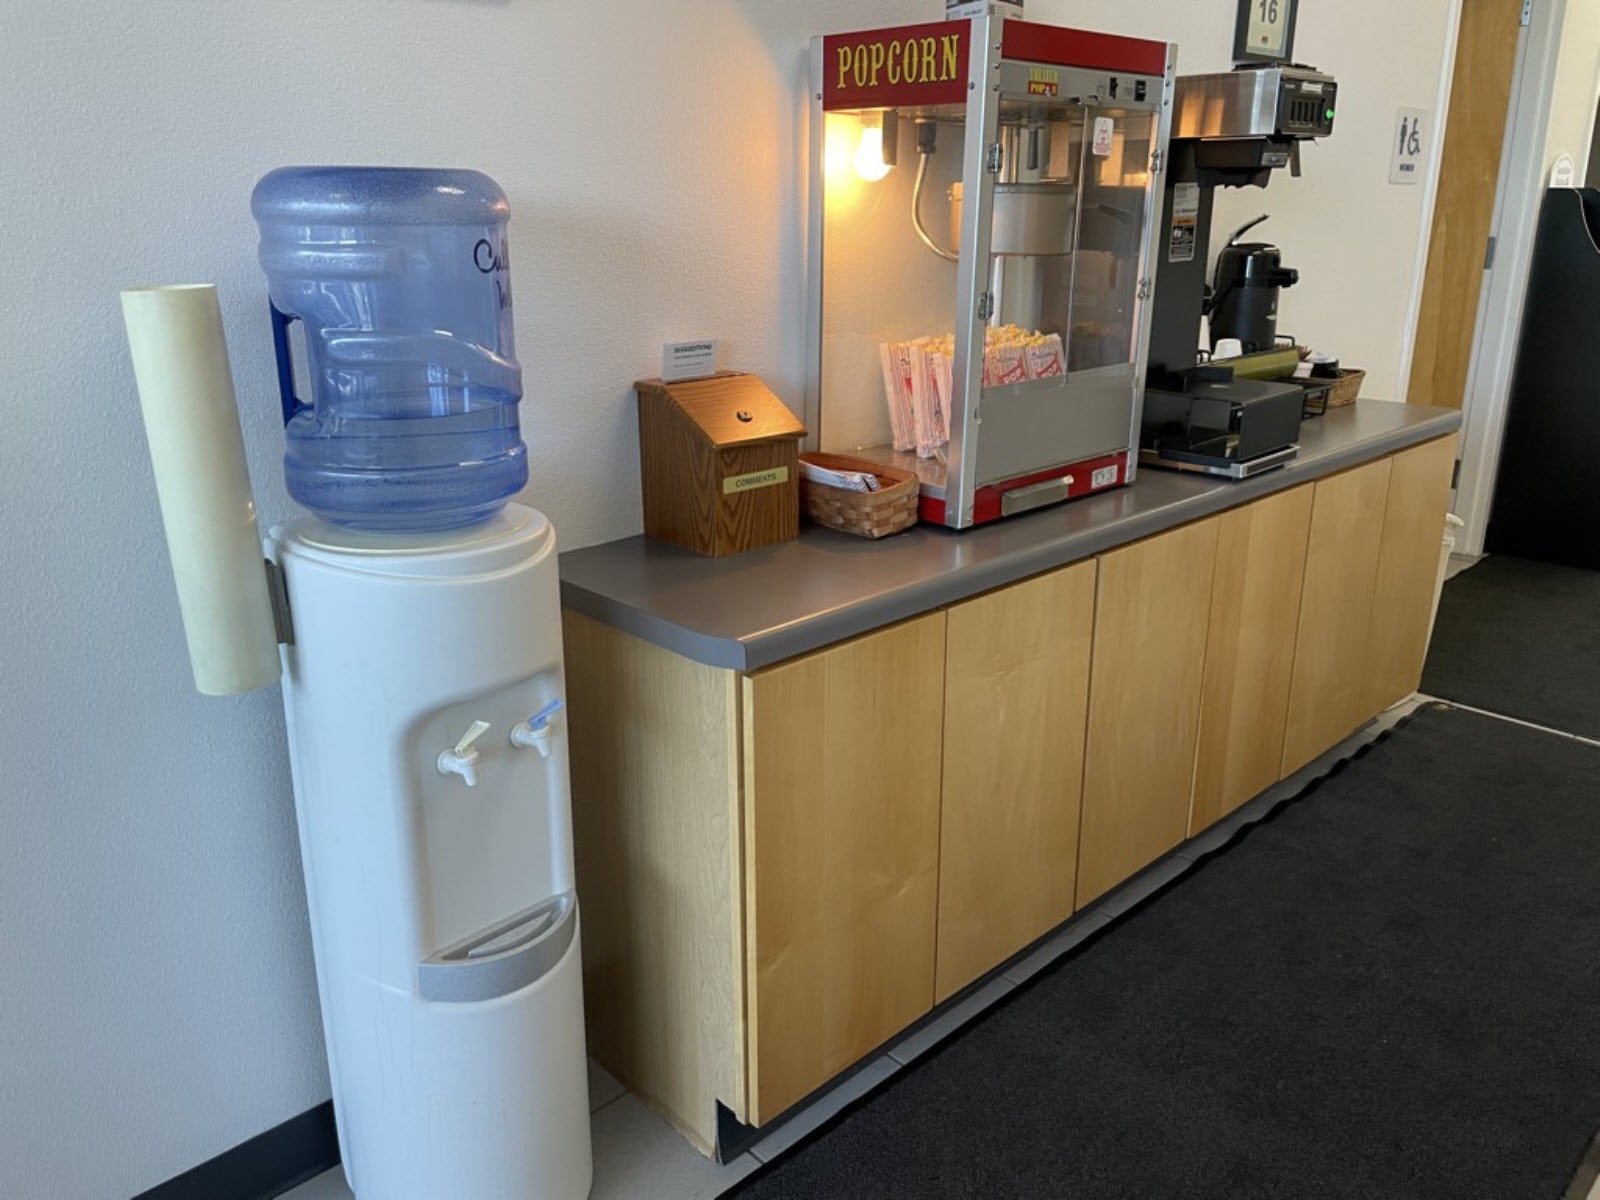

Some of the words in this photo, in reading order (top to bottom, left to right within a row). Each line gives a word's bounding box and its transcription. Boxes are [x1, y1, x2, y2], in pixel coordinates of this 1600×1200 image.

[1259, 0, 1278, 24] 16
[837, 34, 959, 89] POPCORN
[674, 344, 713, 354] SUGGESTIONS
[735, 472, 777, 488] COMMENTS
